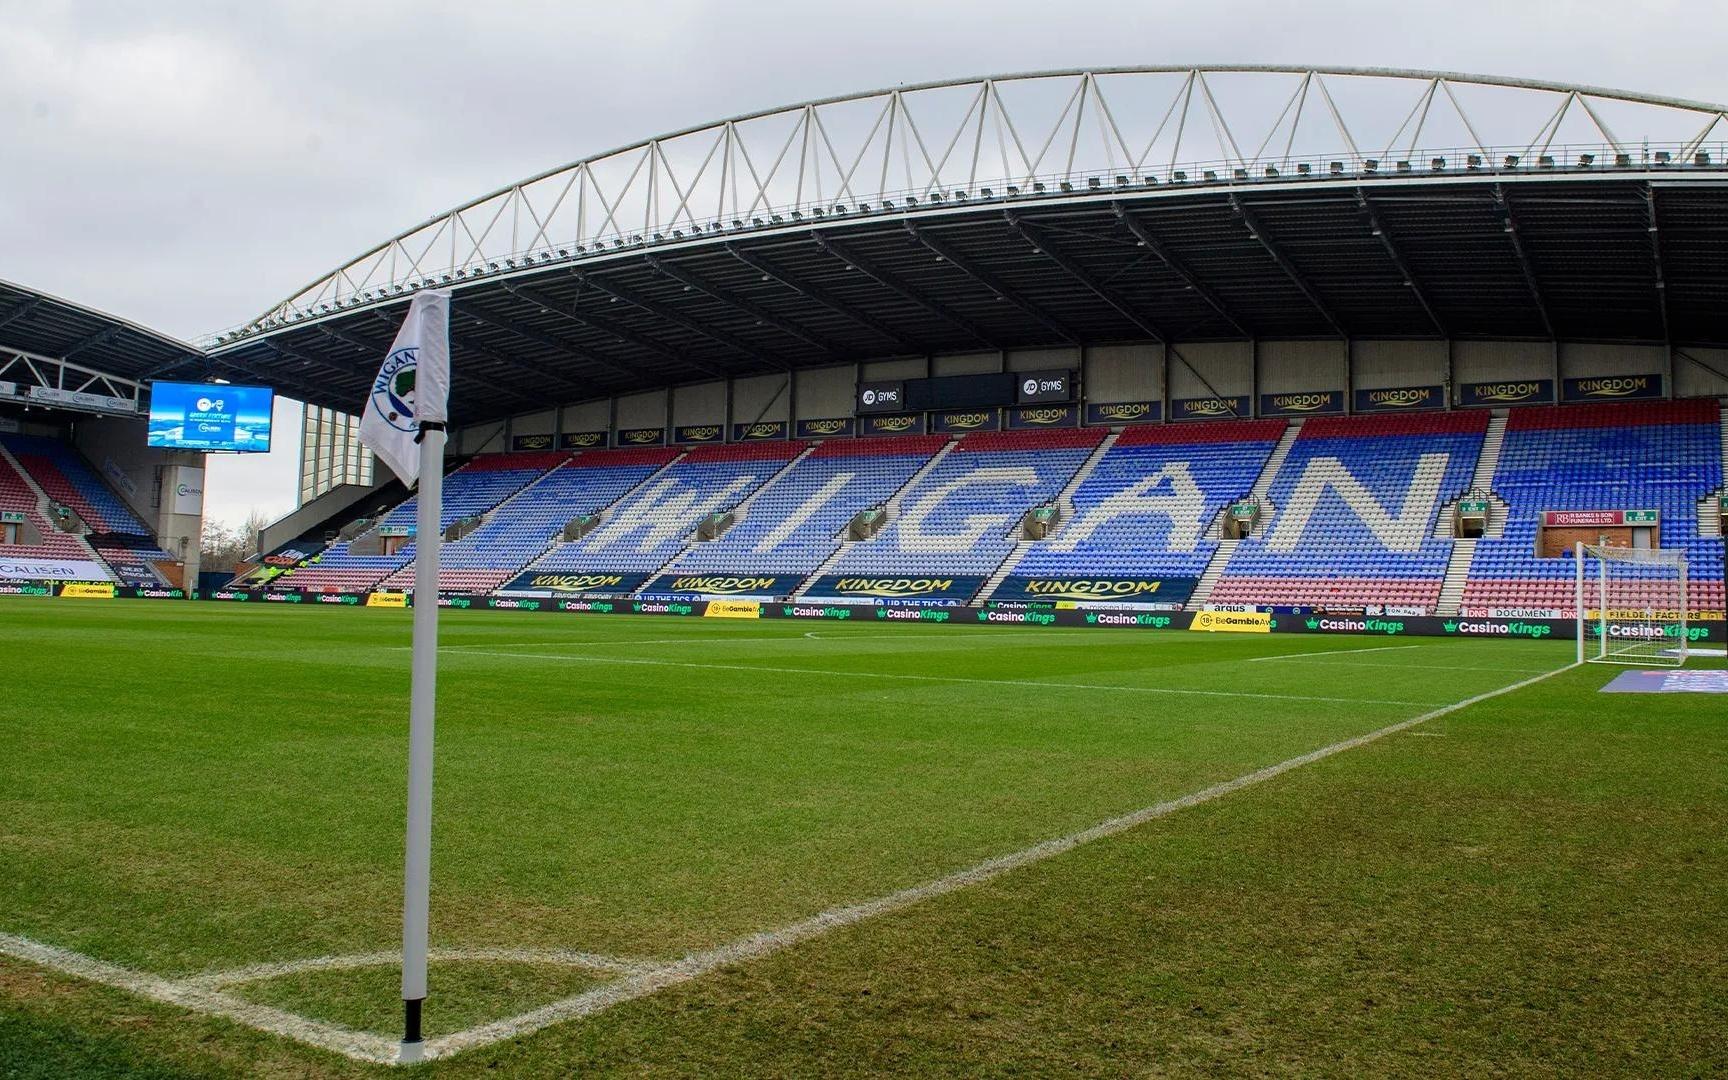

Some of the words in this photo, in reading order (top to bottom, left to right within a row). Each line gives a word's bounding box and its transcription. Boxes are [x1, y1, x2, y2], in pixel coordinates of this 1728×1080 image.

[374, 351, 416, 394] WIGAN
[1041, 380, 1062, 391] GYMS
[1475, 384, 1539, 396] KINGDOM
[1578, 378, 1647, 392] KINGDOM
[878, 391, 897, 401] GYMS
[1273, 394, 1330, 405] KINGDOM
[1369, 390, 1429, 401] KINGDOM
[1020, 409, 1067, 419] KINGDOM
[1099, 404, 1150, 414] KINGDOM
[805, 420, 846, 429] KINGDOM
[873, 417, 916, 427] KINGDOM
[944, 414, 989, 424] KINGDOM
[624, 431, 659, 439] KINGDOM
[682, 427, 718, 436] KINGDOM
[583, 453, 1450, 552] WIGAN
[0, 564, 75, 576] CALISEN
[530, 575, 623, 586] KINGDOM
[671, 577, 776, 589] KINGDOM
[835, 579, 953, 591] KINGDOM
[0, 585, 47, 596] asinoKings
[1025, 580, 1159, 595] KINGDOM
[217, 593, 249, 601] CasinoKings
[267, 593, 302, 602] CasinoKings
[322, 595, 358, 604] CasinoKings
[495, 600, 540, 610] CasinoKings
[566, 601, 613, 612] CasinoKings
[641, 603, 692, 615] CasinoKings
[793, 606, 851, 619] CasinoKings
[887, 607, 949, 621] CasinoKings
[988, 610, 1056, 625] CasinoKings
[1496, 610, 1553, 618] DOCUMENT
[1562, 611, 1577, 619] DN
[1656, 611, 1700, 619] FACTRS
[1098, 612, 1170, 628] CasinoKings
[1320, 618, 1403, 634] CasinoKings
[1459, 621, 1551, 637] CasinoKings
